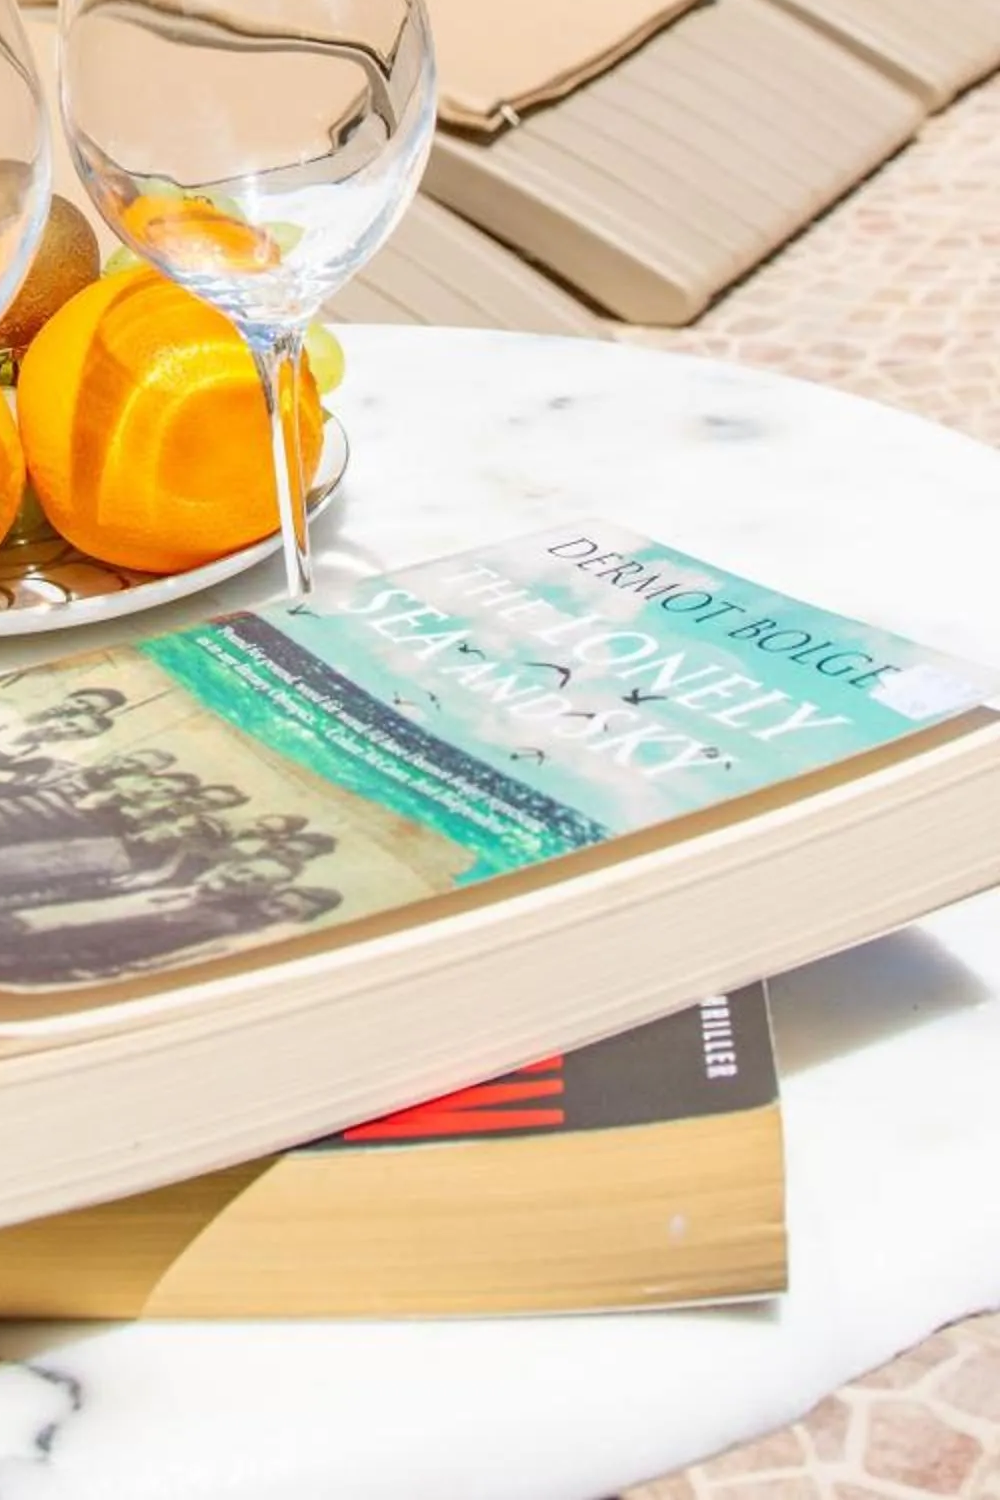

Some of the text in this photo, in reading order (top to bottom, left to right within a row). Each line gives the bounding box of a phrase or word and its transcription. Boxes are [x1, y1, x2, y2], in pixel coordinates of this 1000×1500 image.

[337, 588, 740, 778] SEA AND SKY
[441, 563, 854, 741] THE LONELY
[547, 537, 902, 689] DERMOT BOLGE
[701, 995, 738, 1079] HRILLER
